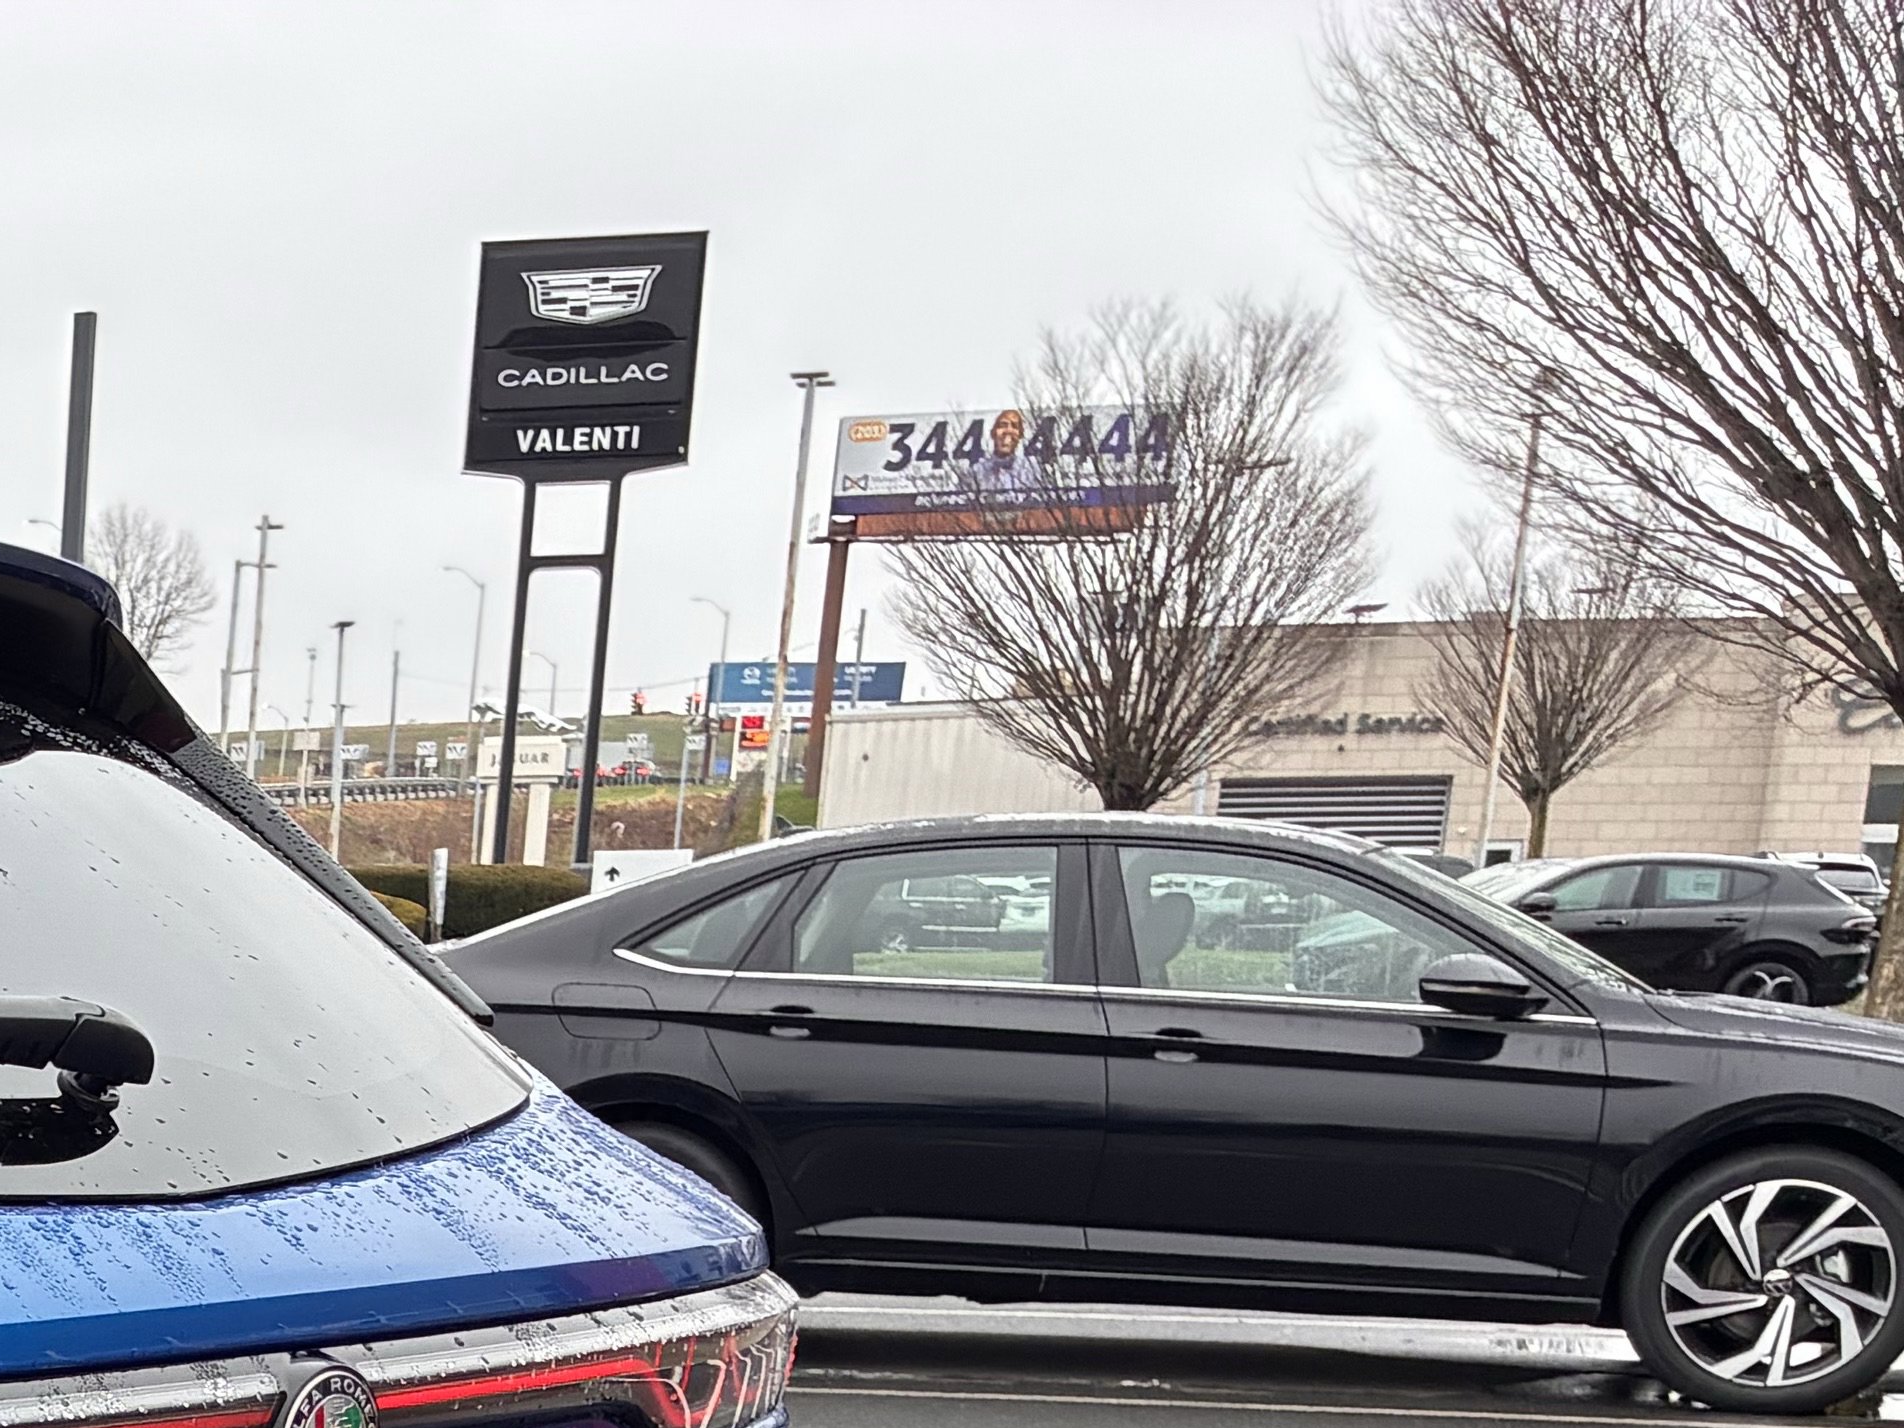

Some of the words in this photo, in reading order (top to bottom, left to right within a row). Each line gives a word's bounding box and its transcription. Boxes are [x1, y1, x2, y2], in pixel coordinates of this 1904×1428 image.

[497, 363, 669, 388] CADILLAC
[516, 425, 641, 453] VALENTI
[882, 419, 986, 472] 344
[490, 752, 550, 768] JUAR
